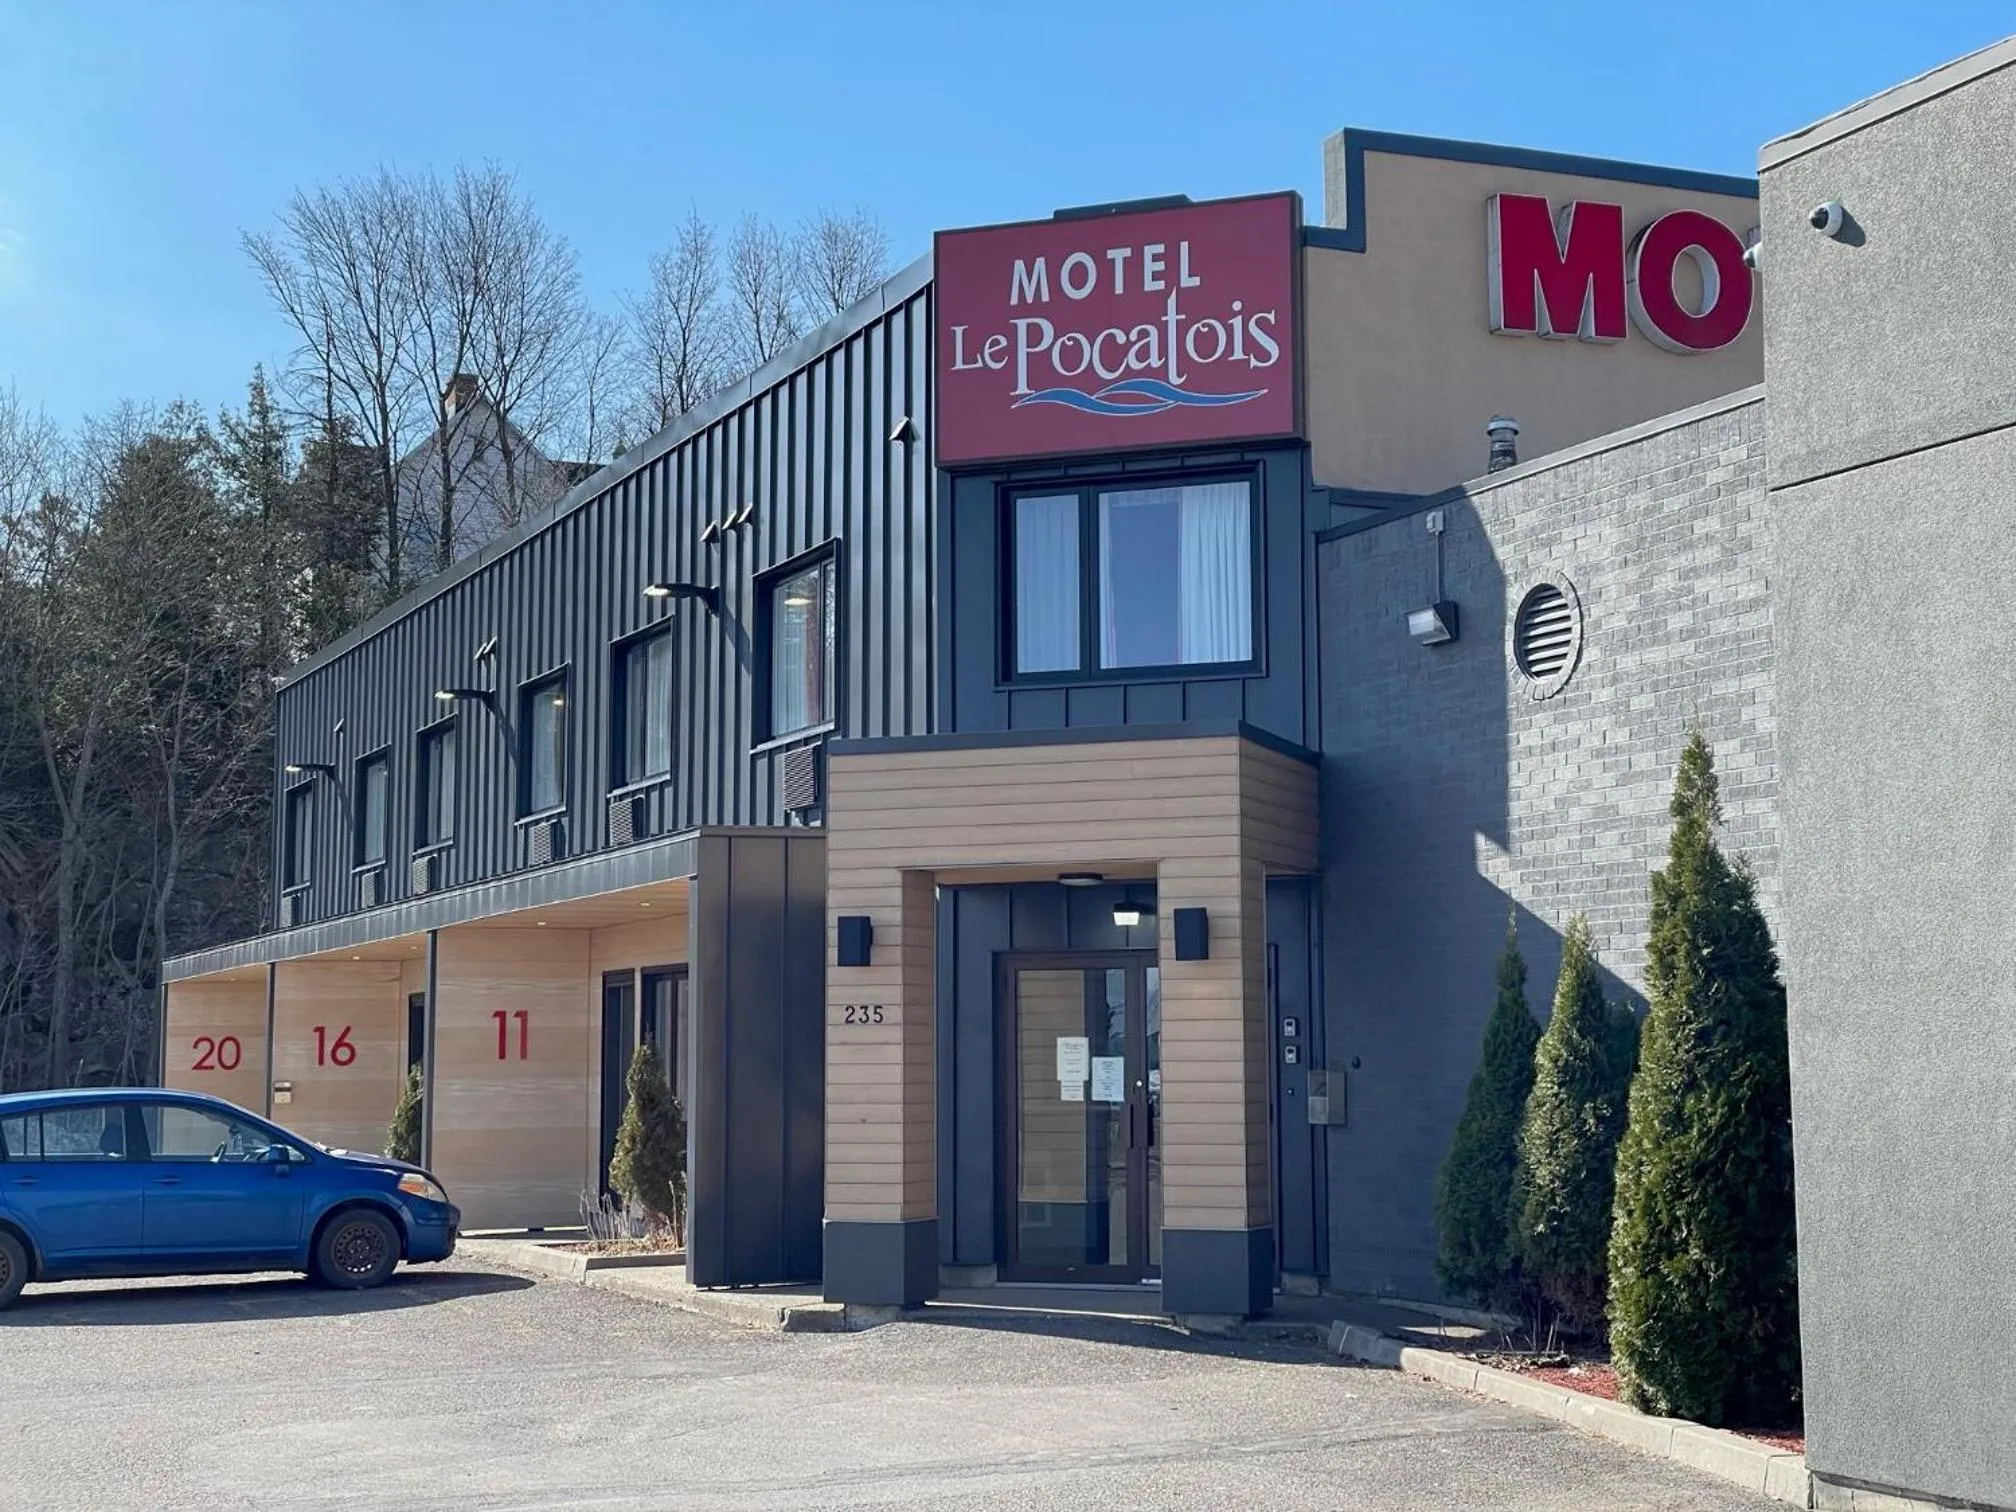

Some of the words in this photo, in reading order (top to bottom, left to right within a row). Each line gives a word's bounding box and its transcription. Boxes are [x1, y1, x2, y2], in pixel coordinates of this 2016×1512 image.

[1010, 241, 1201, 306] MOTEL
[1487, 192, 1761, 354] MO
[951, 325, 1009, 371] Le
[1009, 285, 1280, 396] Pocatois
[491, 1010, 529, 1060] 11
[845, 1005, 884, 1024] 235
[191, 1036, 242, 1071] 20
[312, 1026, 357, 1067] 16
